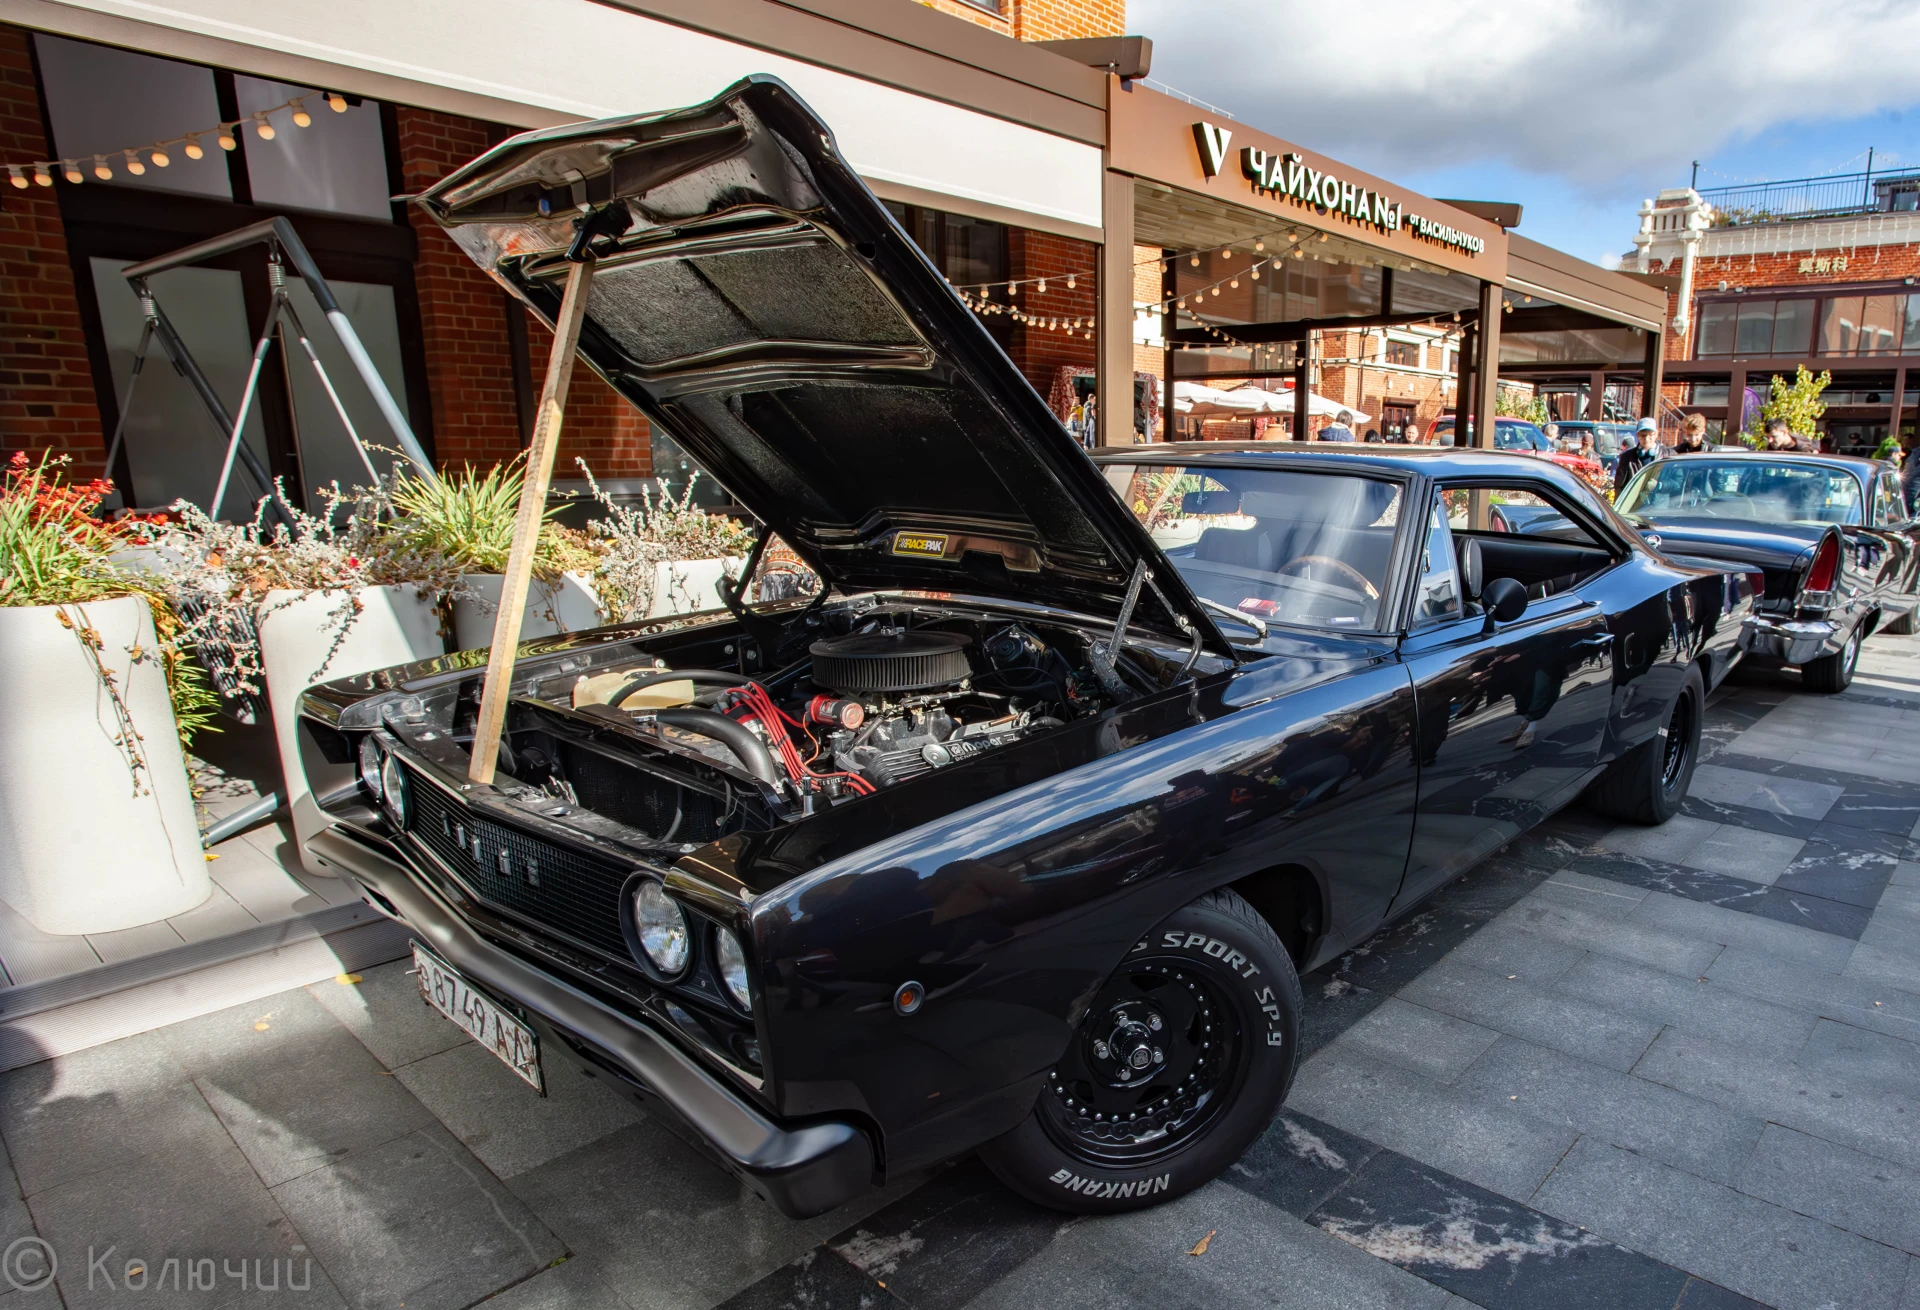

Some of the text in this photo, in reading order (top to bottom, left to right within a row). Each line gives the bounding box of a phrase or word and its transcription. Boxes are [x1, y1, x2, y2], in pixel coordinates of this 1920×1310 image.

[1249, 146, 1371, 221] ЧАЙХОНА
[1420, 216, 1485, 254] ВАСИЛЬЧУКОВ
[1797, 255, 1848, 274] 莫斯科
[1161, 931, 1282, 1046] SPORT SP-9
[1049, 1168, 1170, 1199] NANKANG
